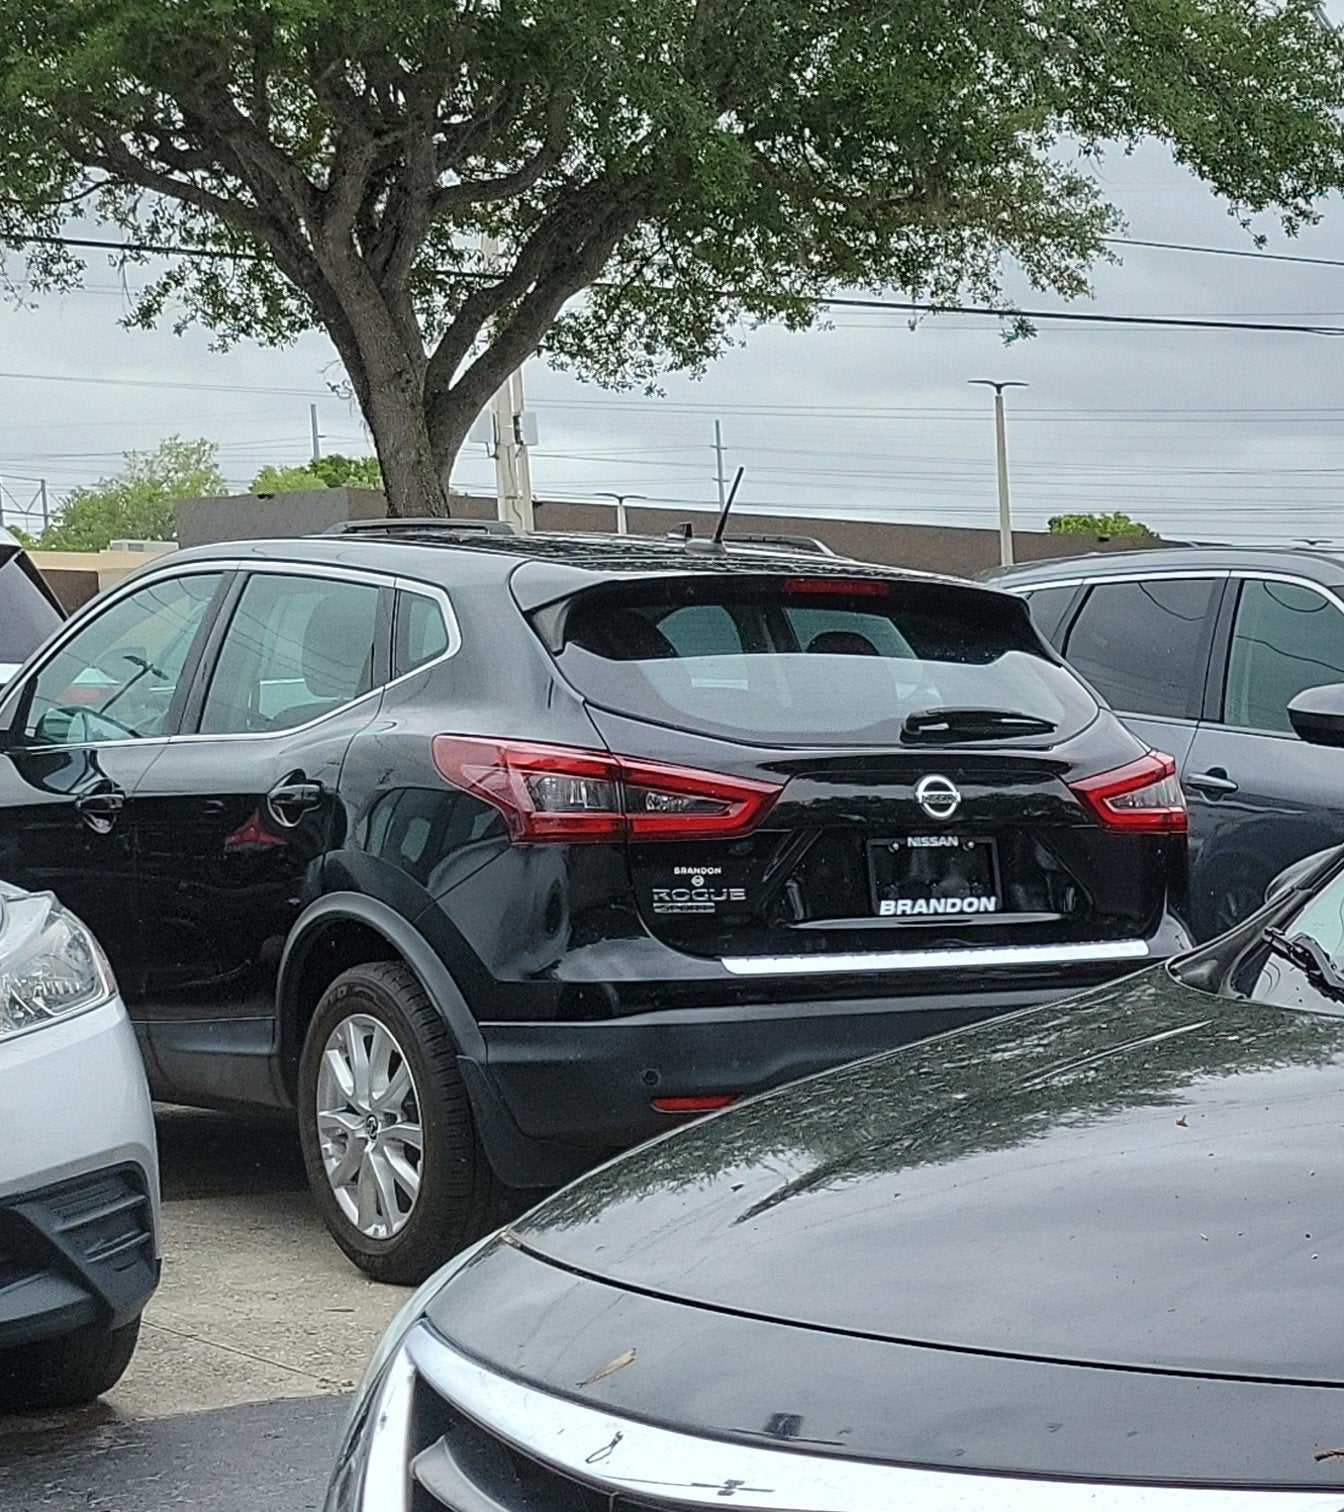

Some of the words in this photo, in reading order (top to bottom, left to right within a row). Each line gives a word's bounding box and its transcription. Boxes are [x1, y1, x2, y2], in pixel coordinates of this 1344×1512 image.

[907, 836, 959, 847] NISSAN
[674, 867, 722, 875] BRANDON
[652, 888, 746, 900] ROGUE
[879, 896, 997, 916] BRANDON
